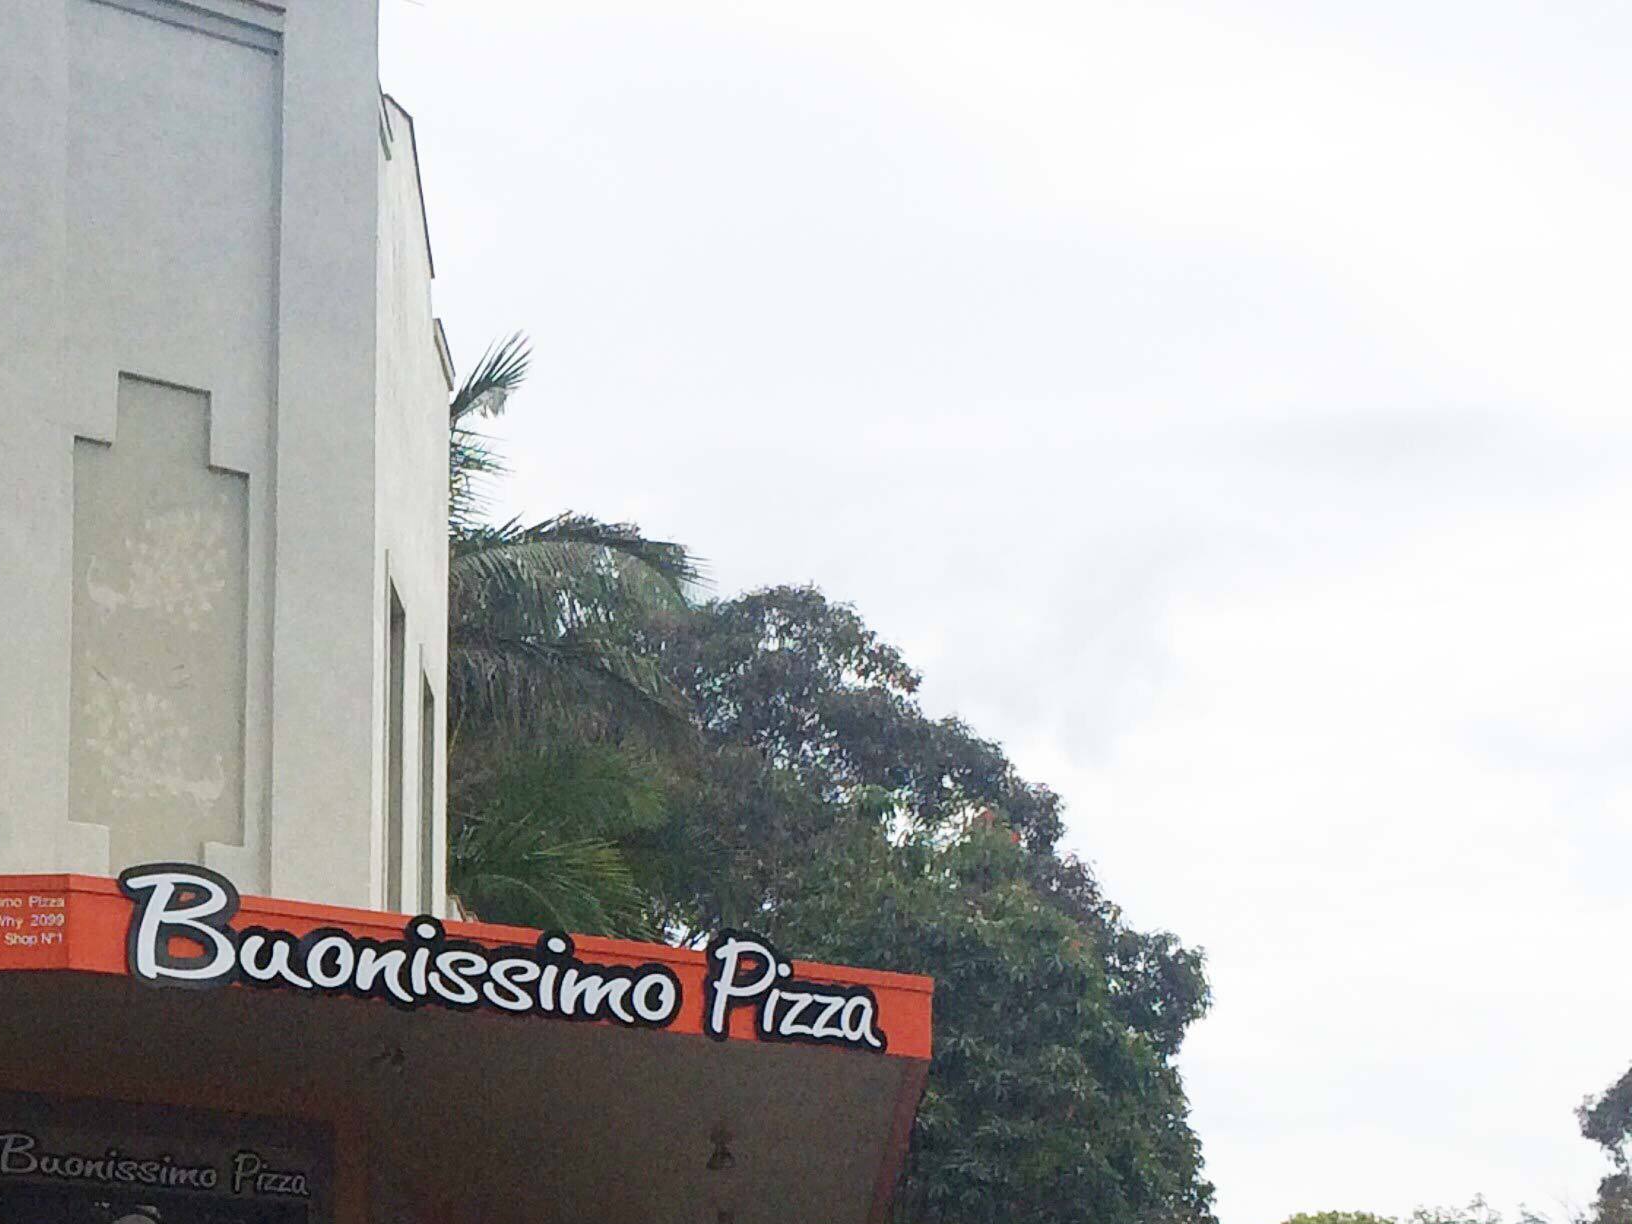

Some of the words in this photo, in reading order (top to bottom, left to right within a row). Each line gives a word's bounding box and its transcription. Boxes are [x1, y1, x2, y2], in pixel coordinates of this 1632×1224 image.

[28, 895, 65, 908] Pizza
[29, 913, 65, 927] 2099
[4, 932, 38, 947] Shop
[125, 872, 677, 1024] Buonissimo
[710, 936, 883, 1049] Pizza
[233, 1152, 311, 1197] Pizza
